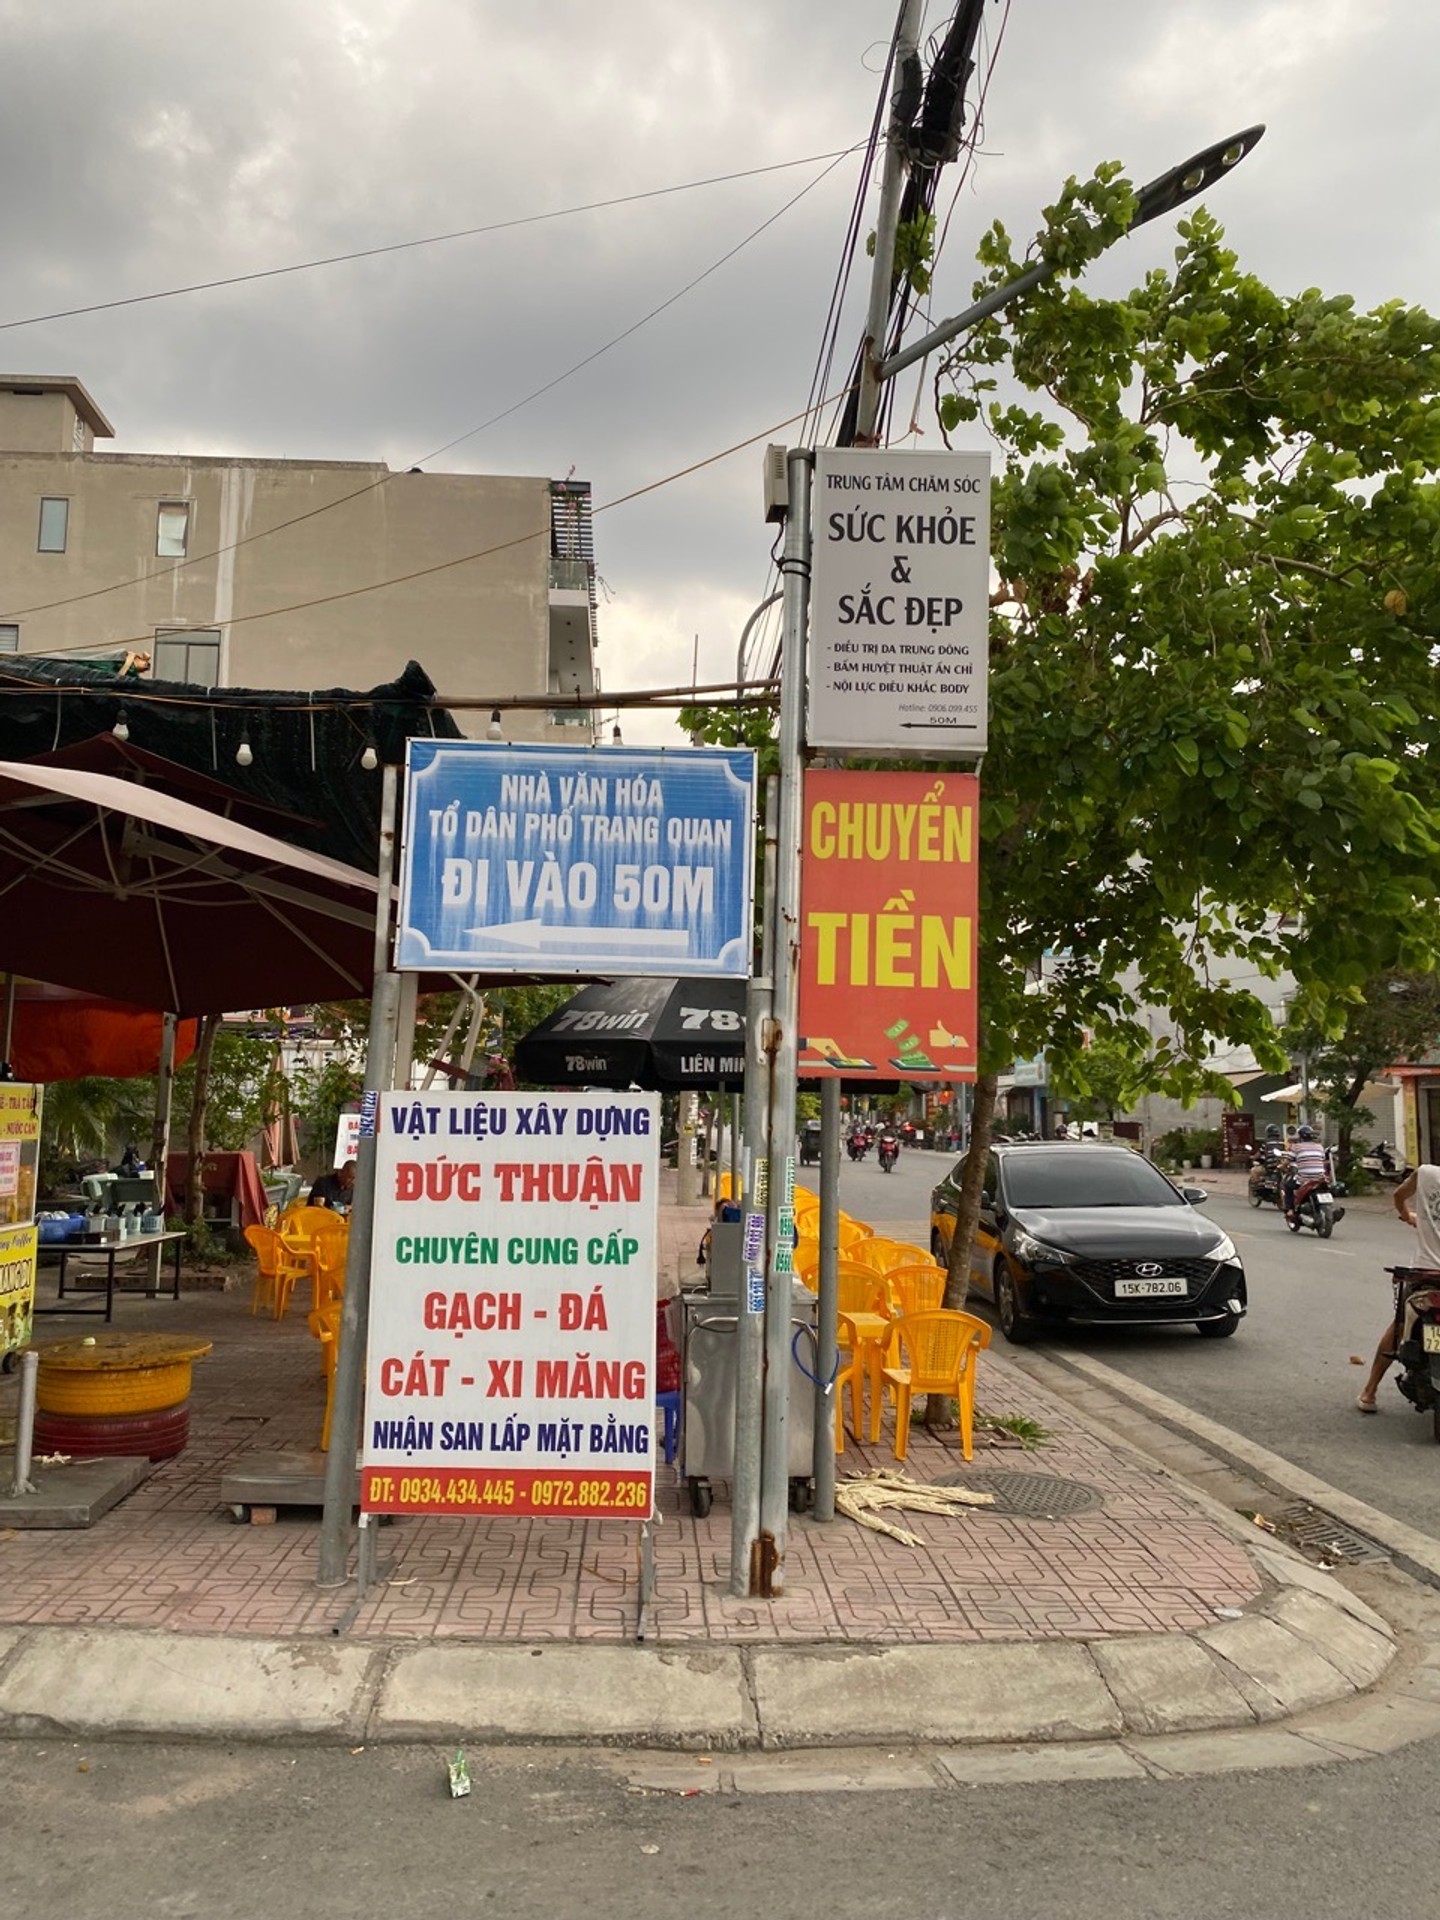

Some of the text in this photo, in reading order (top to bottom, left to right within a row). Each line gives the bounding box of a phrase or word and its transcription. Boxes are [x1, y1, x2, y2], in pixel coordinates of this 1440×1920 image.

[826, 472, 981, 494] TRUNG TÂM CHĂM SÓC
[828, 505, 977, 545] SỨC KHỎE
[890, 555, 911, 584] &
[838, 582, 963, 635] SẮC ĐẸP
[833, 658, 859, 672] BẤM
[862, 662, 896, 676] HUYỆT
[899, 663, 933, 676] THUẬT
[935, 662, 951, 675] ẤN
[862, 643, 878, 656] TRỊ
[881, 644, 896, 654] DA
[900, 644, 935, 656] TRUNG
[833, 680, 852, 693] NỘI
[855, 682, 876, 695] LỰC
[907, 680, 938, 693] KHẮC
[940, 684, 970, 693] BODY
[930, 716, 957, 724] 50M
[501, 770, 663, 806] NHÀ VĂN HÓA
[429, 800, 732, 847] TỔ DÂN PHỐ TRANG QUAN
[810, 779, 972, 863] CHUYỂN
[441, 851, 714, 913] ĐI VÀO 50M
[807, 888, 972, 990] TIỀN
[551, 1008, 650, 1031] 78win
[679, 1006, 746, 1030] 78
[565, 1055, 607, 1072] 78win
[681, 1053, 715, 1073] LIÊN
[392, 1102, 441, 1140] VẬT
[450, 1102, 507, 1141] LIỆU
[516, 1102, 568, 1135] XÂY
[576, 1105, 650, 1141] DỰNG
[395, 1155, 643, 1210] ĐỨC THUẬN
[396, 1229, 639, 1266] CHUYÊN CUNG CẤP
[1122, 1281, 1182, 1294] 15K-782.06
[424, 1286, 608, 1338] GẠCH - ĐÁ
[380, 1350, 646, 1400] CÁT - XI MĂNG
[373, 1412, 648, 1458] NHẬN SAN LẤP MẶT BẰNG
[370, 1477, 395, 1502] ĐT:
[400, 1478, 514, 1506] 0934.434.445
[532, 1480, 647, 1508] 0972.882.236
